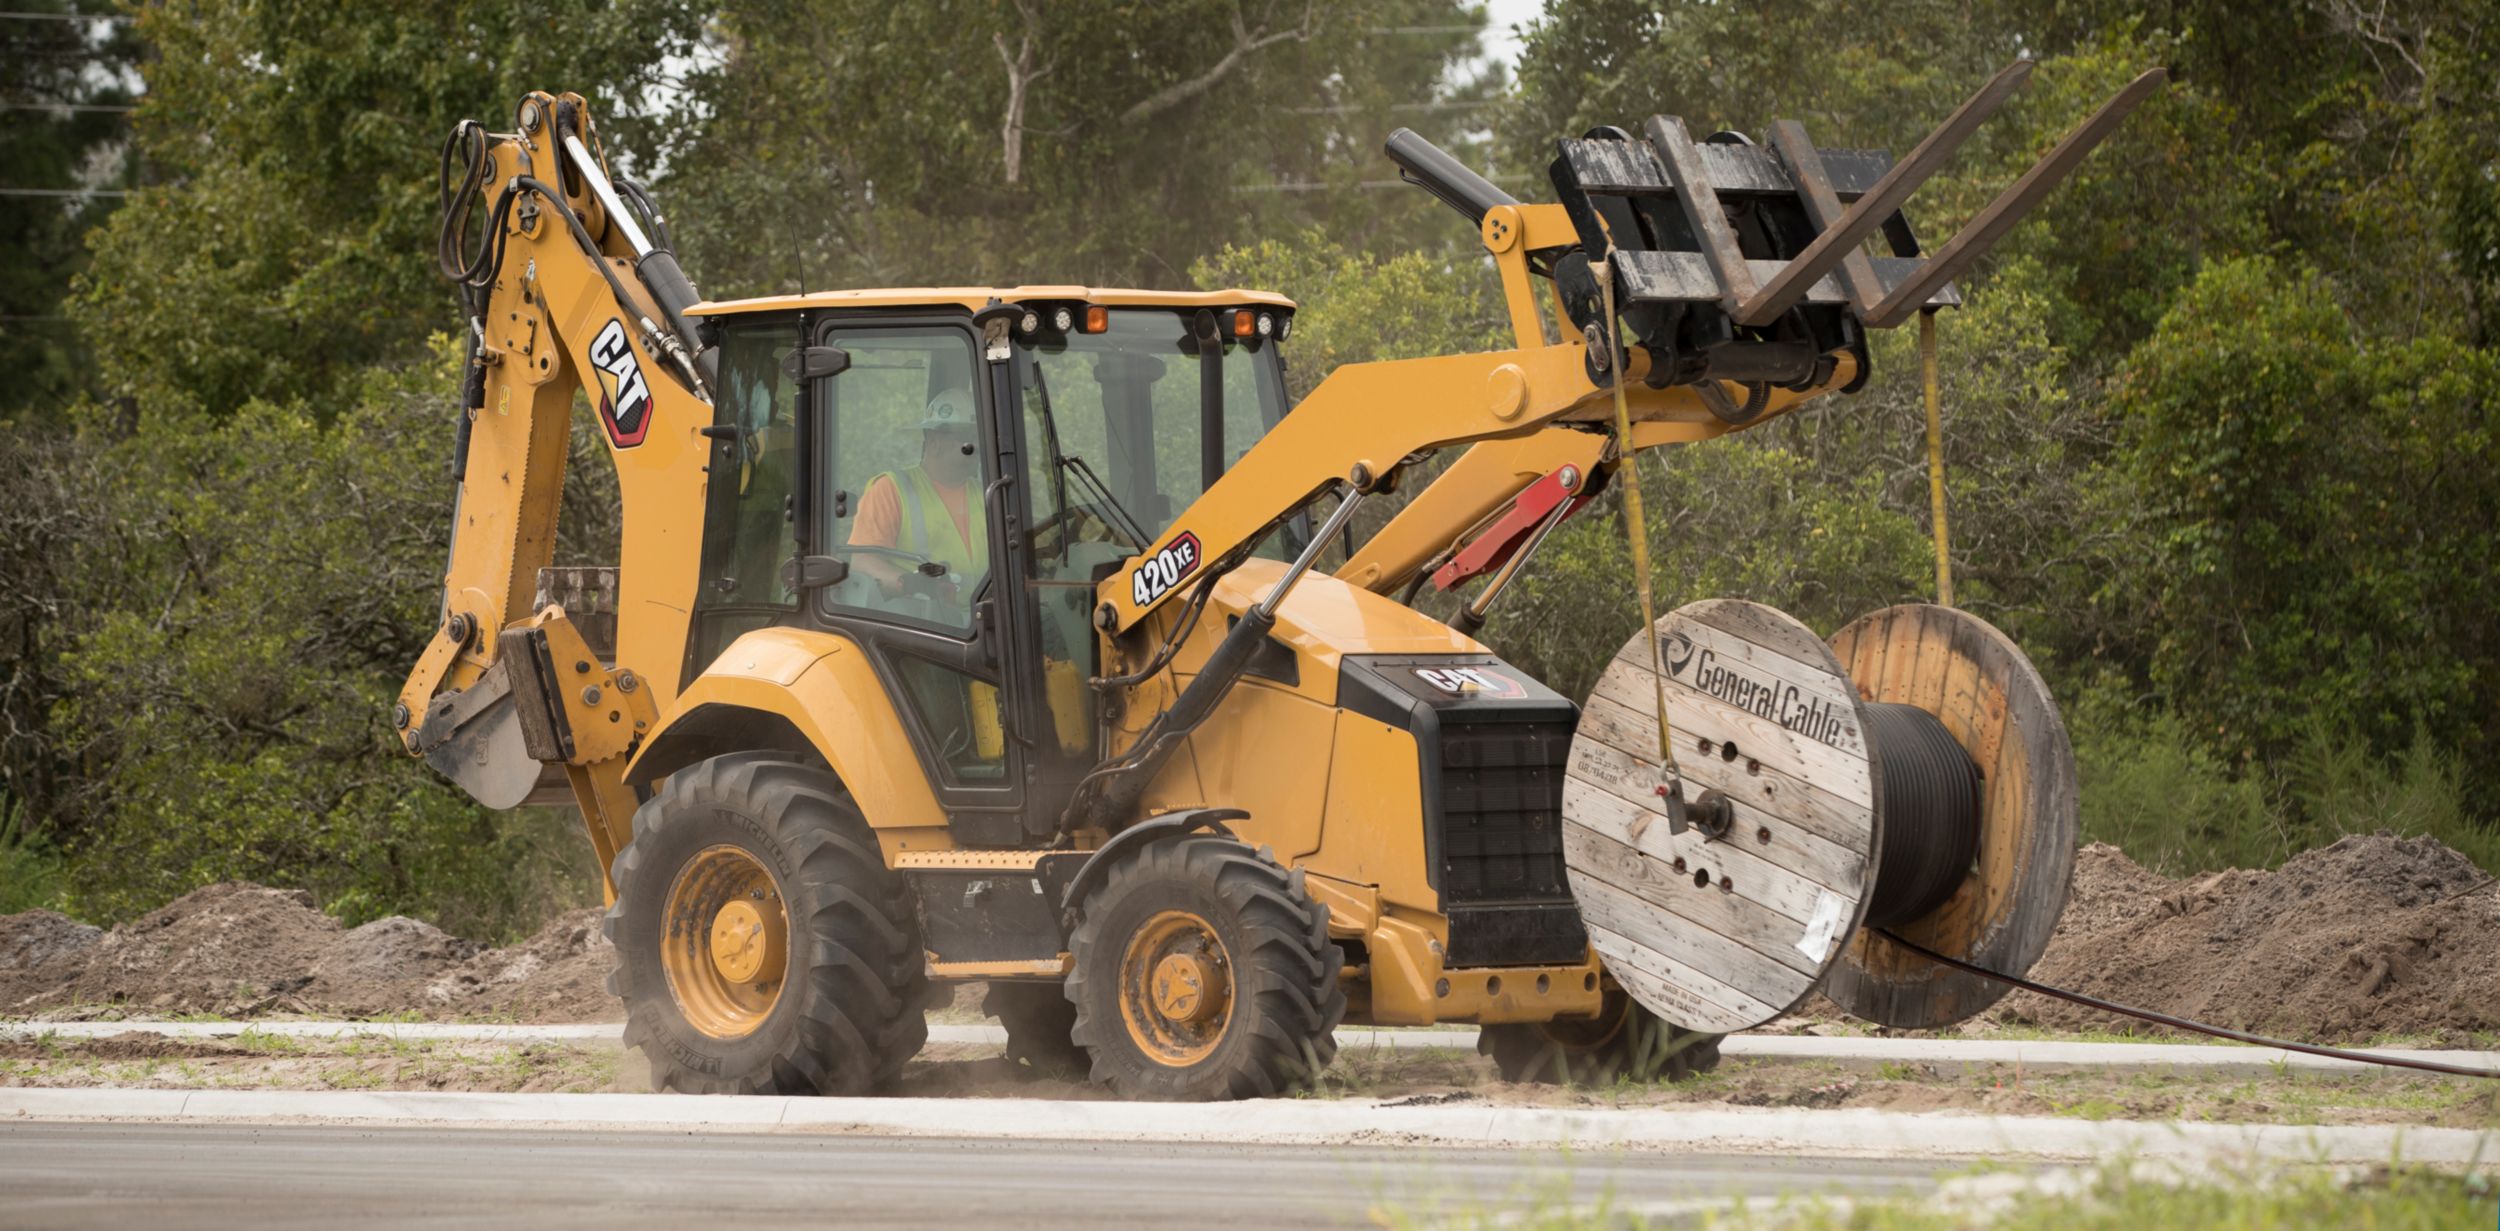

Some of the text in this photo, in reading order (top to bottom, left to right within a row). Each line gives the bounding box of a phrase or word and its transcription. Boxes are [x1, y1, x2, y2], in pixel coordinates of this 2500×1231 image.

[590, 319, 649, 421] CAT
[1415, 668, 1502, 692] CAT
[1695, 648, 1841, 746] General Cable
[730, 810, 792, 879] MICHELIN
